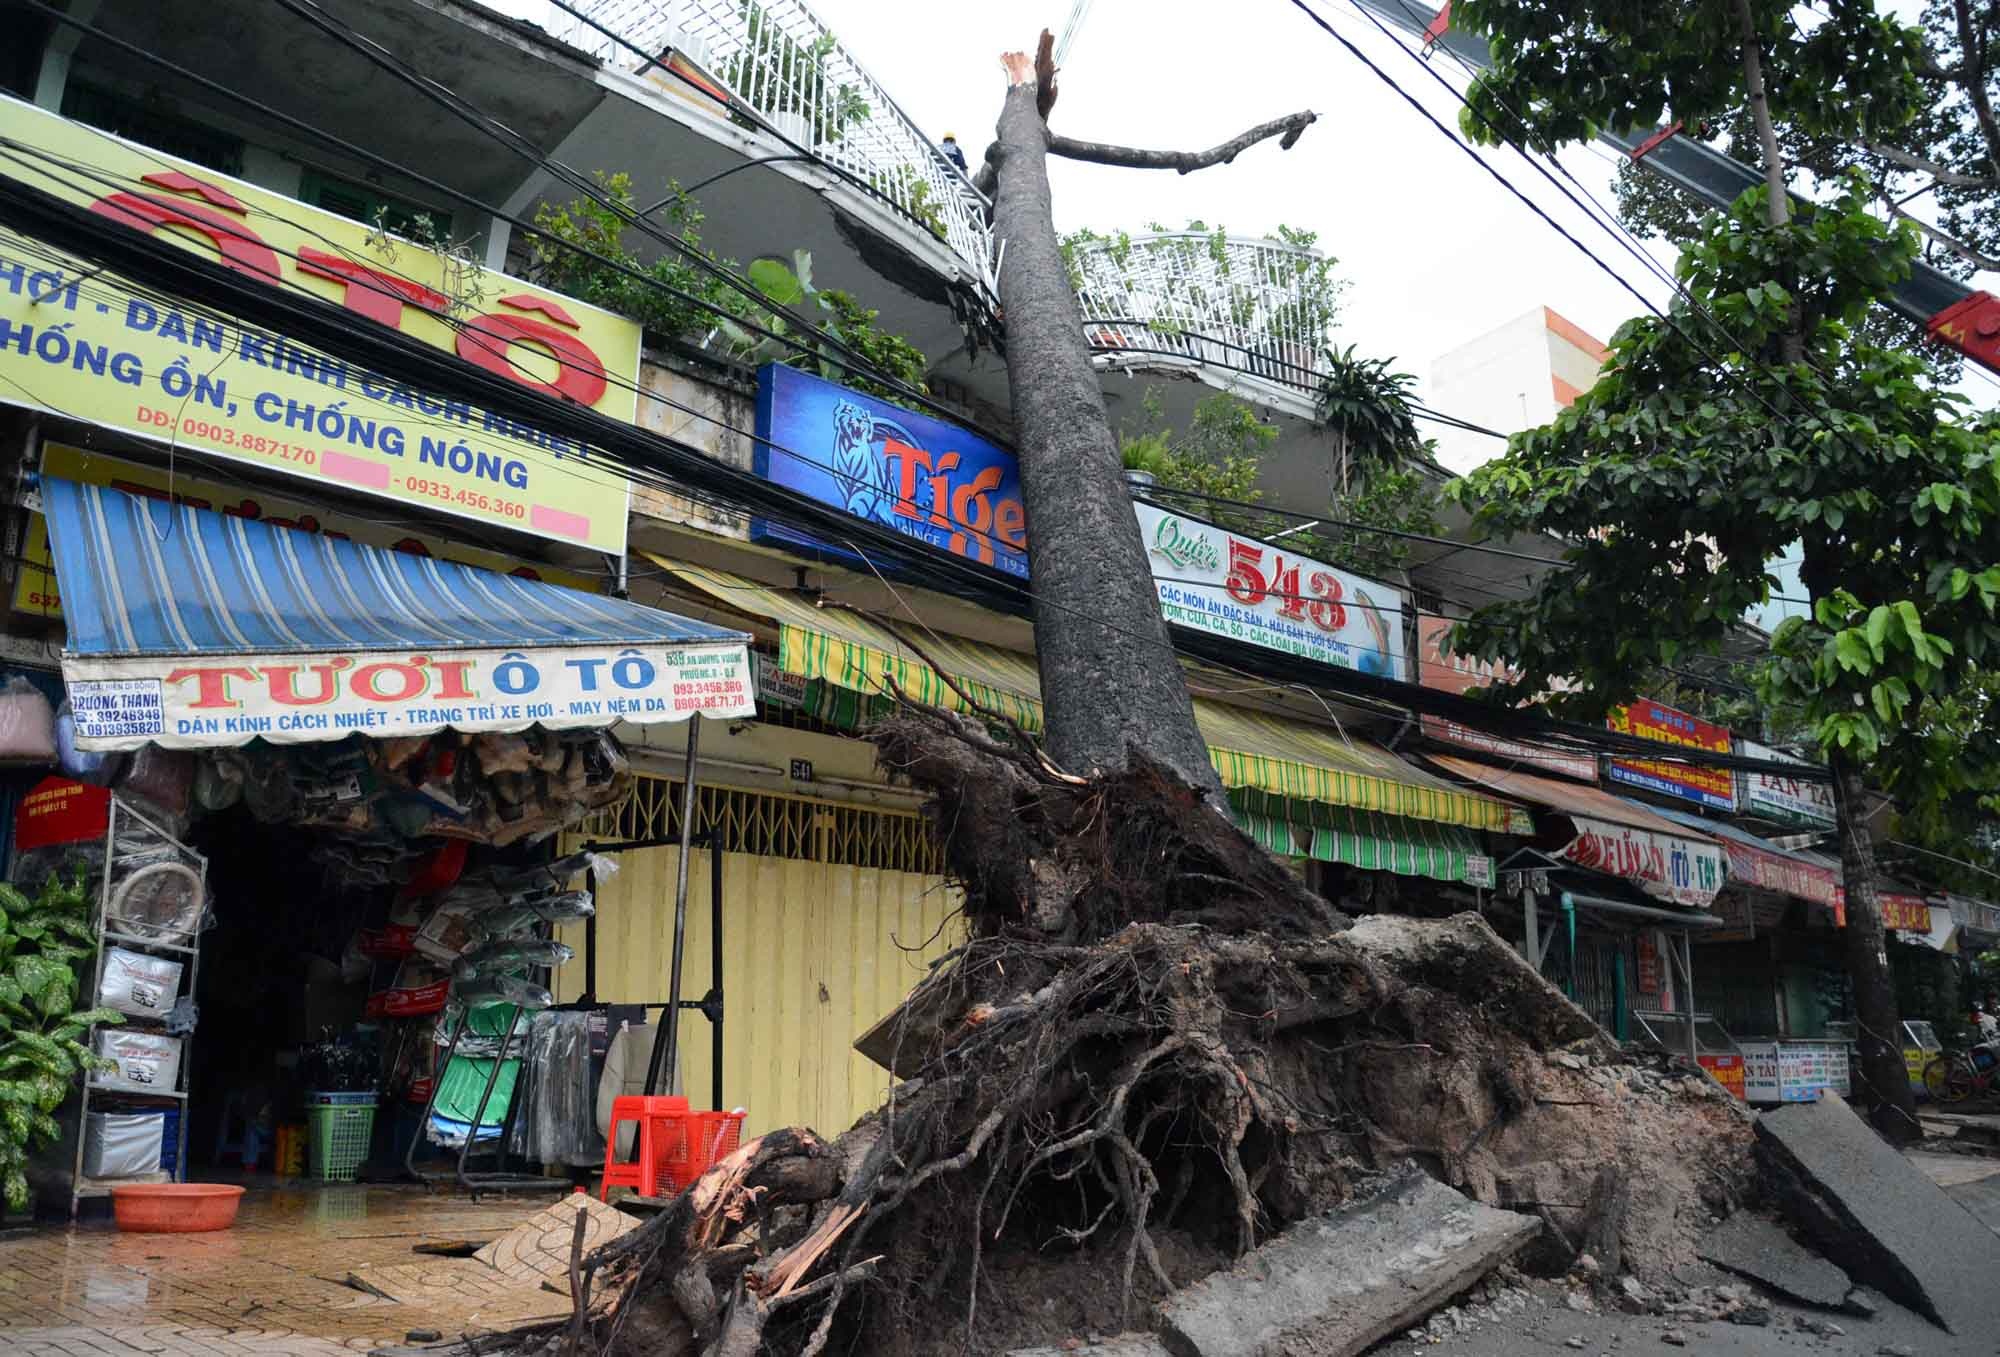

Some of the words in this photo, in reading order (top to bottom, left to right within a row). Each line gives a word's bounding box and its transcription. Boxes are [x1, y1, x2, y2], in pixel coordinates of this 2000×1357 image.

[239, 331, 347, 389] KÍNH
[137, 406, 176, 430] DĐ:
[183, 419, 317, 465] 0903.887170
[406, 476, 525, 519] 0933.456.360
[254, 391, 405, 457] CHỐNG
[419, 438, 529, 490] NÓNG
[884, 436, 1026, 566] Tige
[1160, 584, 1181, 602] CÁC
[1183, 591, 1206, 610] MÓN
[1224, 534, 1347, 633] 543
[492, 652, 540, 695] Ô
[564, 649, 656, 692] TÔ
[178, 714, 222, 735] DÁN
[226, 712, 271, 733] KÍNH
[278, 710, 328, 730] CÁCH
[335, 707, 388, 730] NHIỆT
[406, 706, 462, 725] TRANG
[466, 700, 496, 721] TRÍ
[501, 704, 525, 719] XE
[527, 701, 553, 718] HƠI
[569, 701, 601, 717] MAY
[607, 696, 641, 716] NỆM
[645, 698, 666, 714] DA
